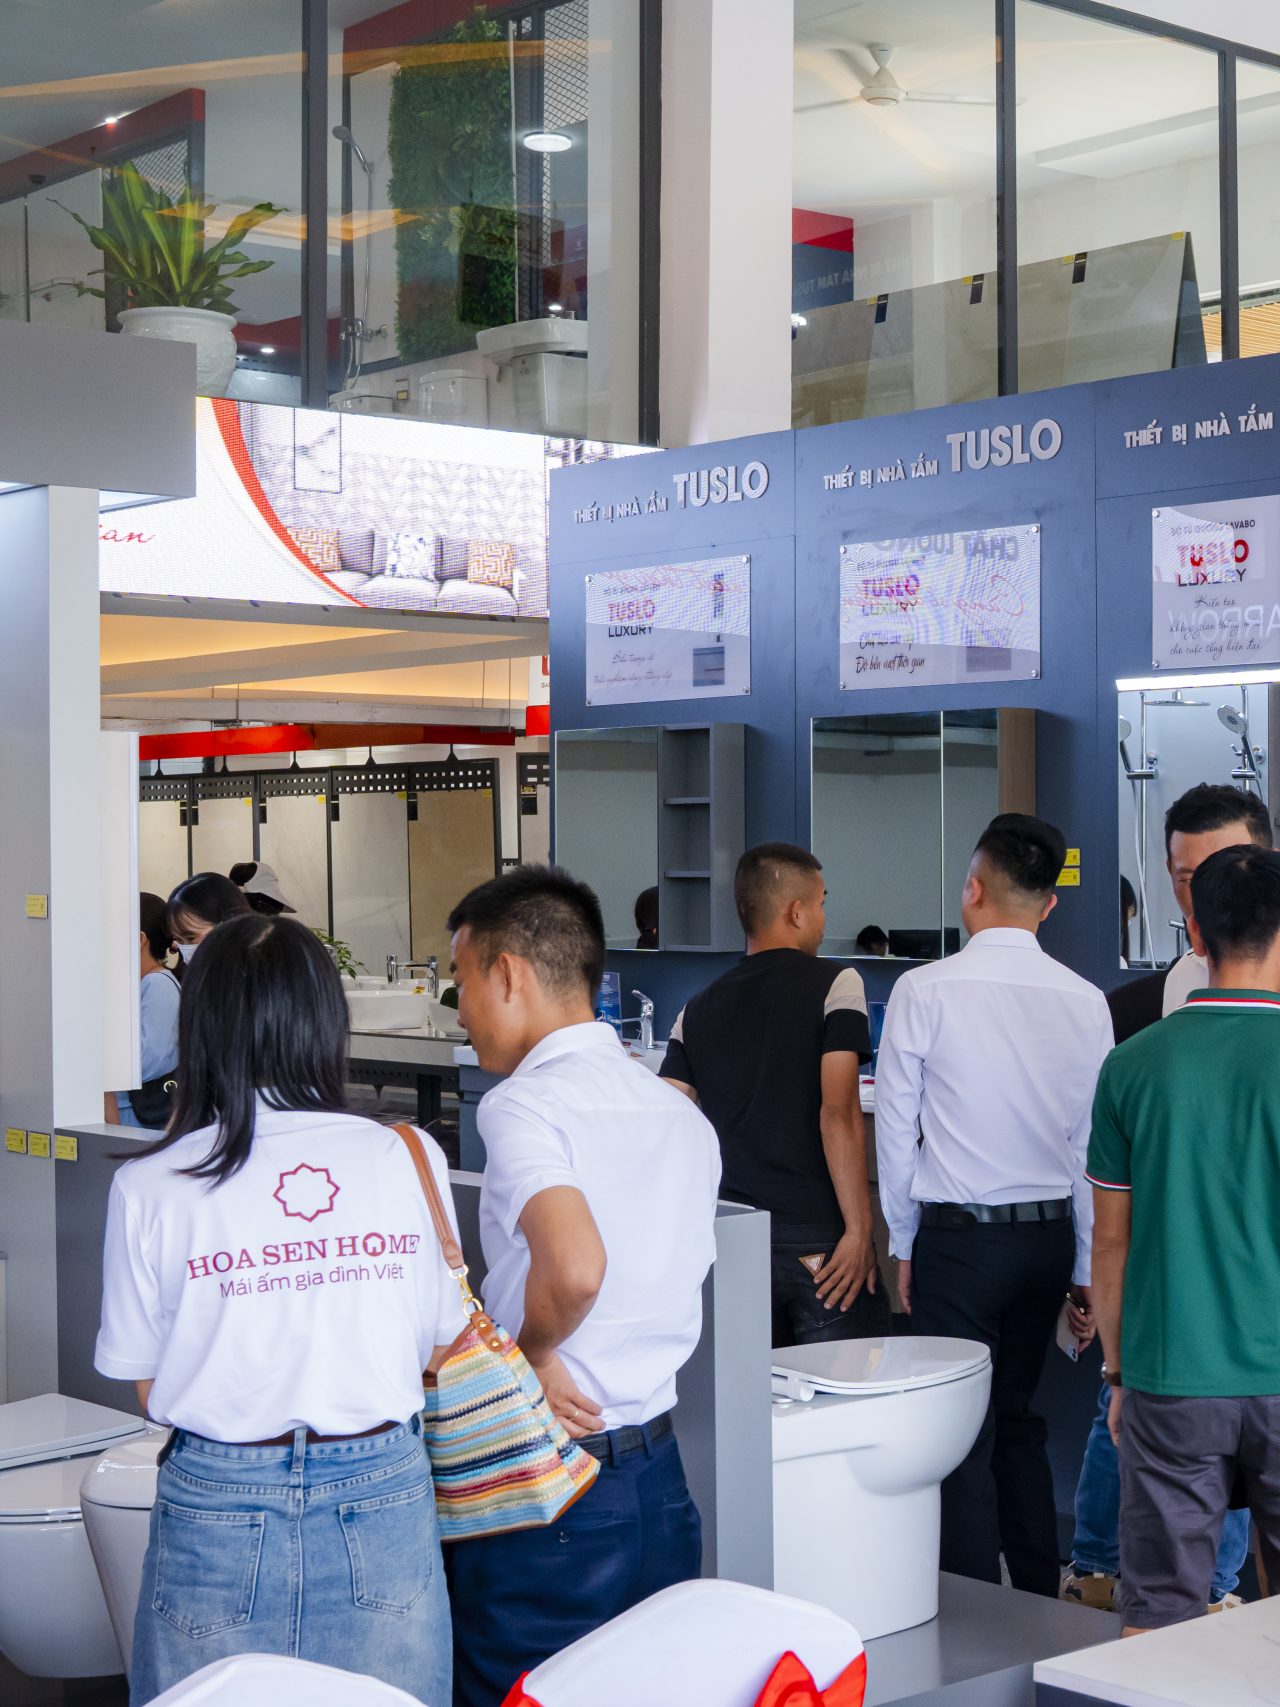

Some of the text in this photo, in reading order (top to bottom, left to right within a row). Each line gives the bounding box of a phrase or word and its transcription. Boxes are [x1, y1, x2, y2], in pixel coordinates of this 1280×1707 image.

[1124, 419, 1163, 448] THIẾT
[1172, 423, 1187, 446] BỊ
[1195, 411, 1231, 439] NHÀ
[1238, 403, 1274, 433] TẮM
[823, 418, 1063, 490] THIẾT BỊ NHÀ TẮM TUSLO
[573, 501, 600, 524] THIẾT
[616, 496, 641, 518] NHÀ
[673, 461, 770, 509] TUSLO
[99, 525, 156, 543] an
[1177, 539, 1249, 567] TUSLO
[187, 1231, 421, 1280] HOA SEN HOME
[219, 1263, 404, 1299] Mái ấm gia đình Việt
